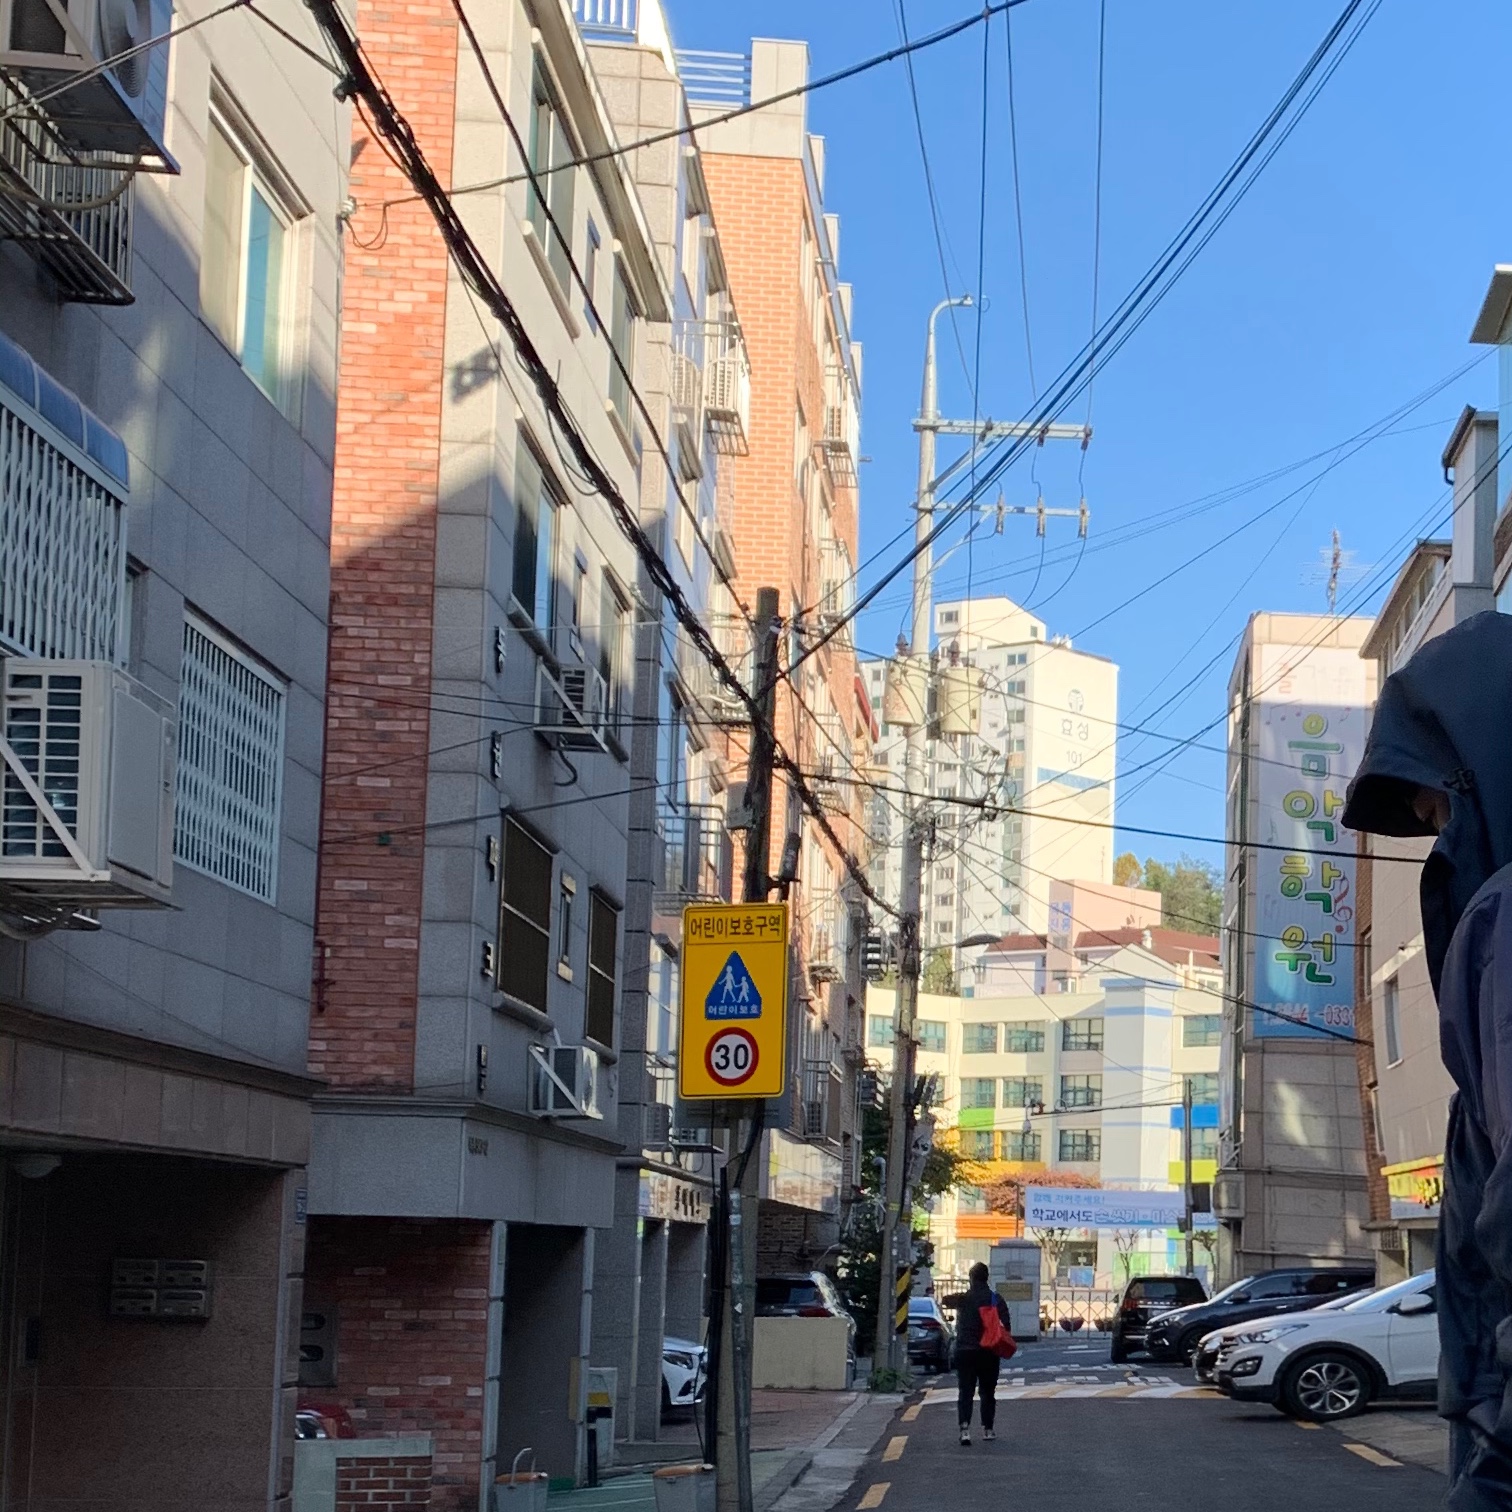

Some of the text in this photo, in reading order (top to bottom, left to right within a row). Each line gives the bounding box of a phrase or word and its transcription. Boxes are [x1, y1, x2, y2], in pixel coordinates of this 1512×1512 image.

[1061, 718, 1089, 741] 효성
[1066, 750, 1083, 764] 101
[1275, 713, 1345, 985] 음악학원
[690, 914, 781, 939] 어린이보호구역
[708, 1003, 760, 1016] 어린이보호
[714, 1043, 750, 1070] 30
[1032, 1207, 1093, 1222] 학교에서도
